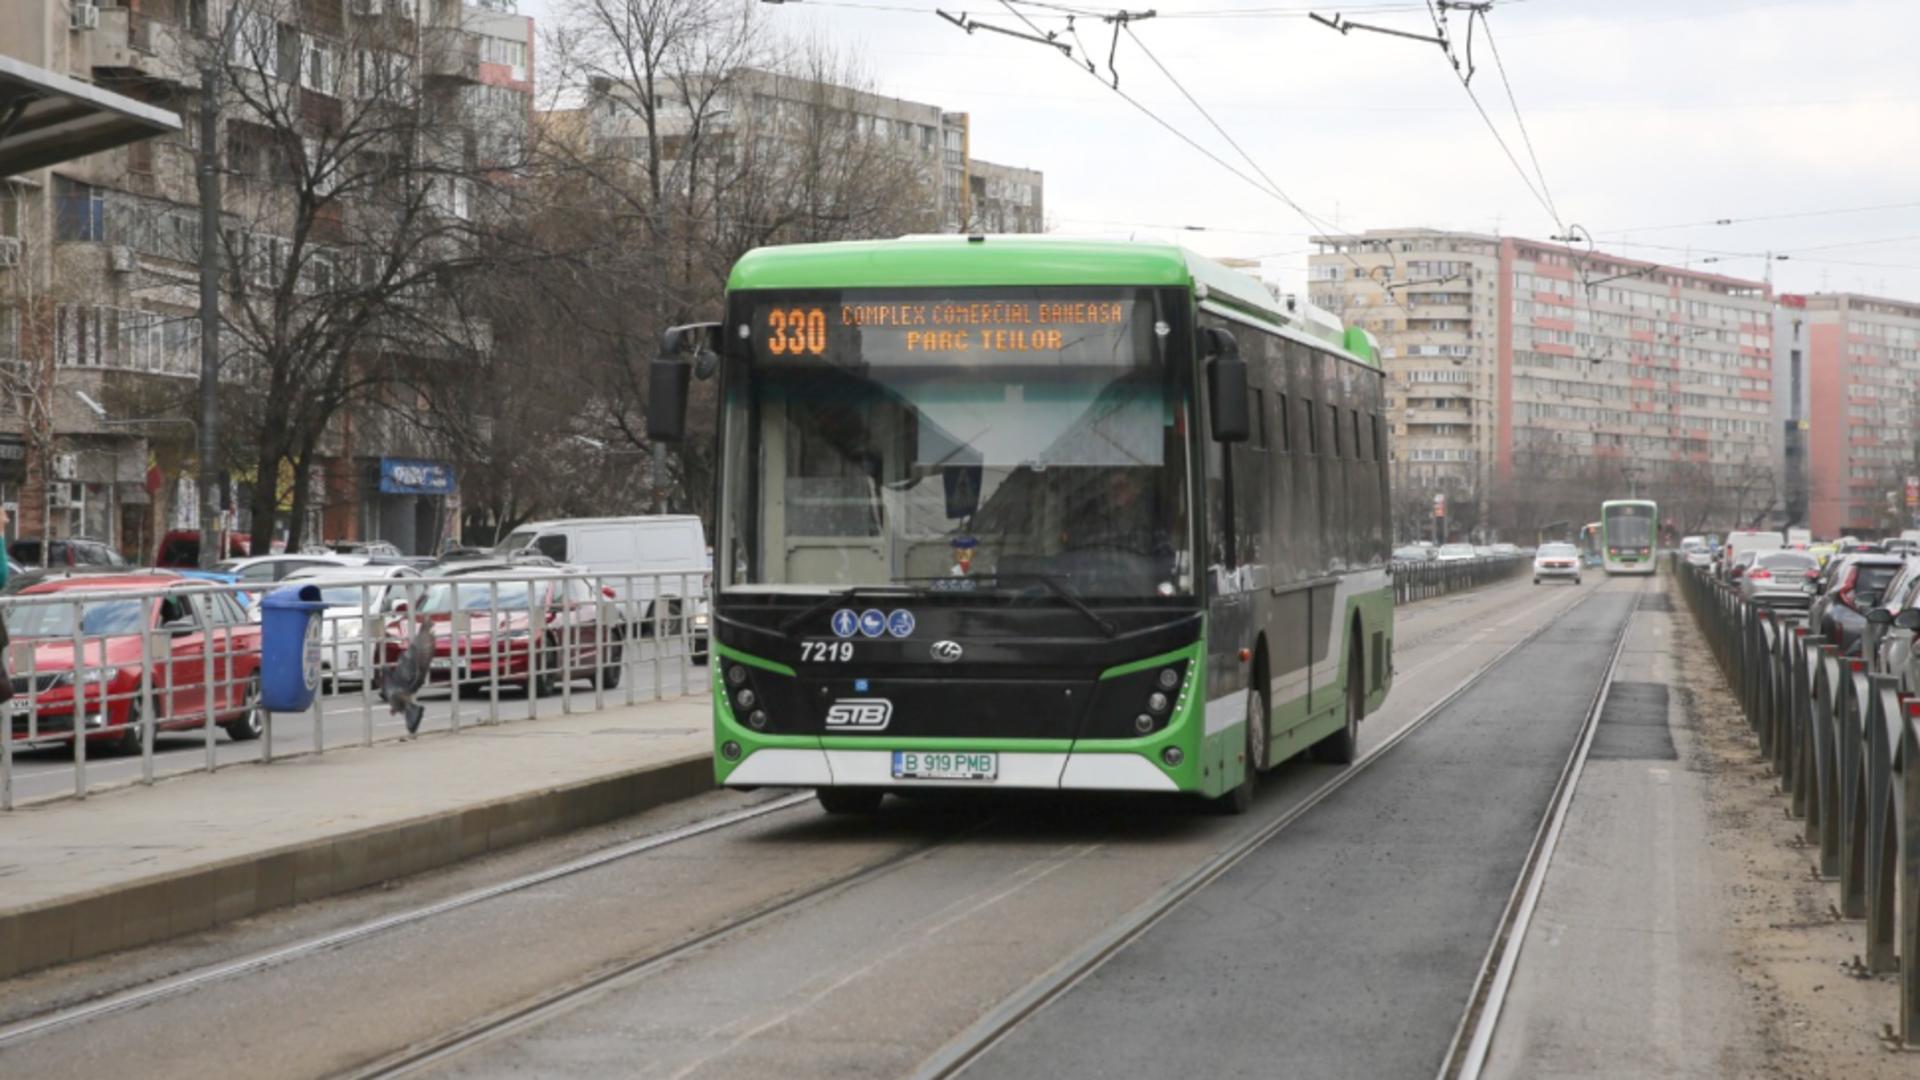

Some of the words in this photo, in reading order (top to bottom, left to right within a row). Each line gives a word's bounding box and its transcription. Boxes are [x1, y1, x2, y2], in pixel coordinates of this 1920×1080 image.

[842, 306, 925, 326] COMPLEX
[932, 303, 1032, 324] COMERCIAL
[768, 308, 826, 355] 330
[906, 330, 969, 351] PARC
[981, 329, 1062, 351] TEILOR
[801, 642, 854, 662] 7219
[825, 703, 886, 725] STB
[905, 754, 918, 771] B
[924, 754, 951, 771] 919
[955, 755, 991, 772] PMB
